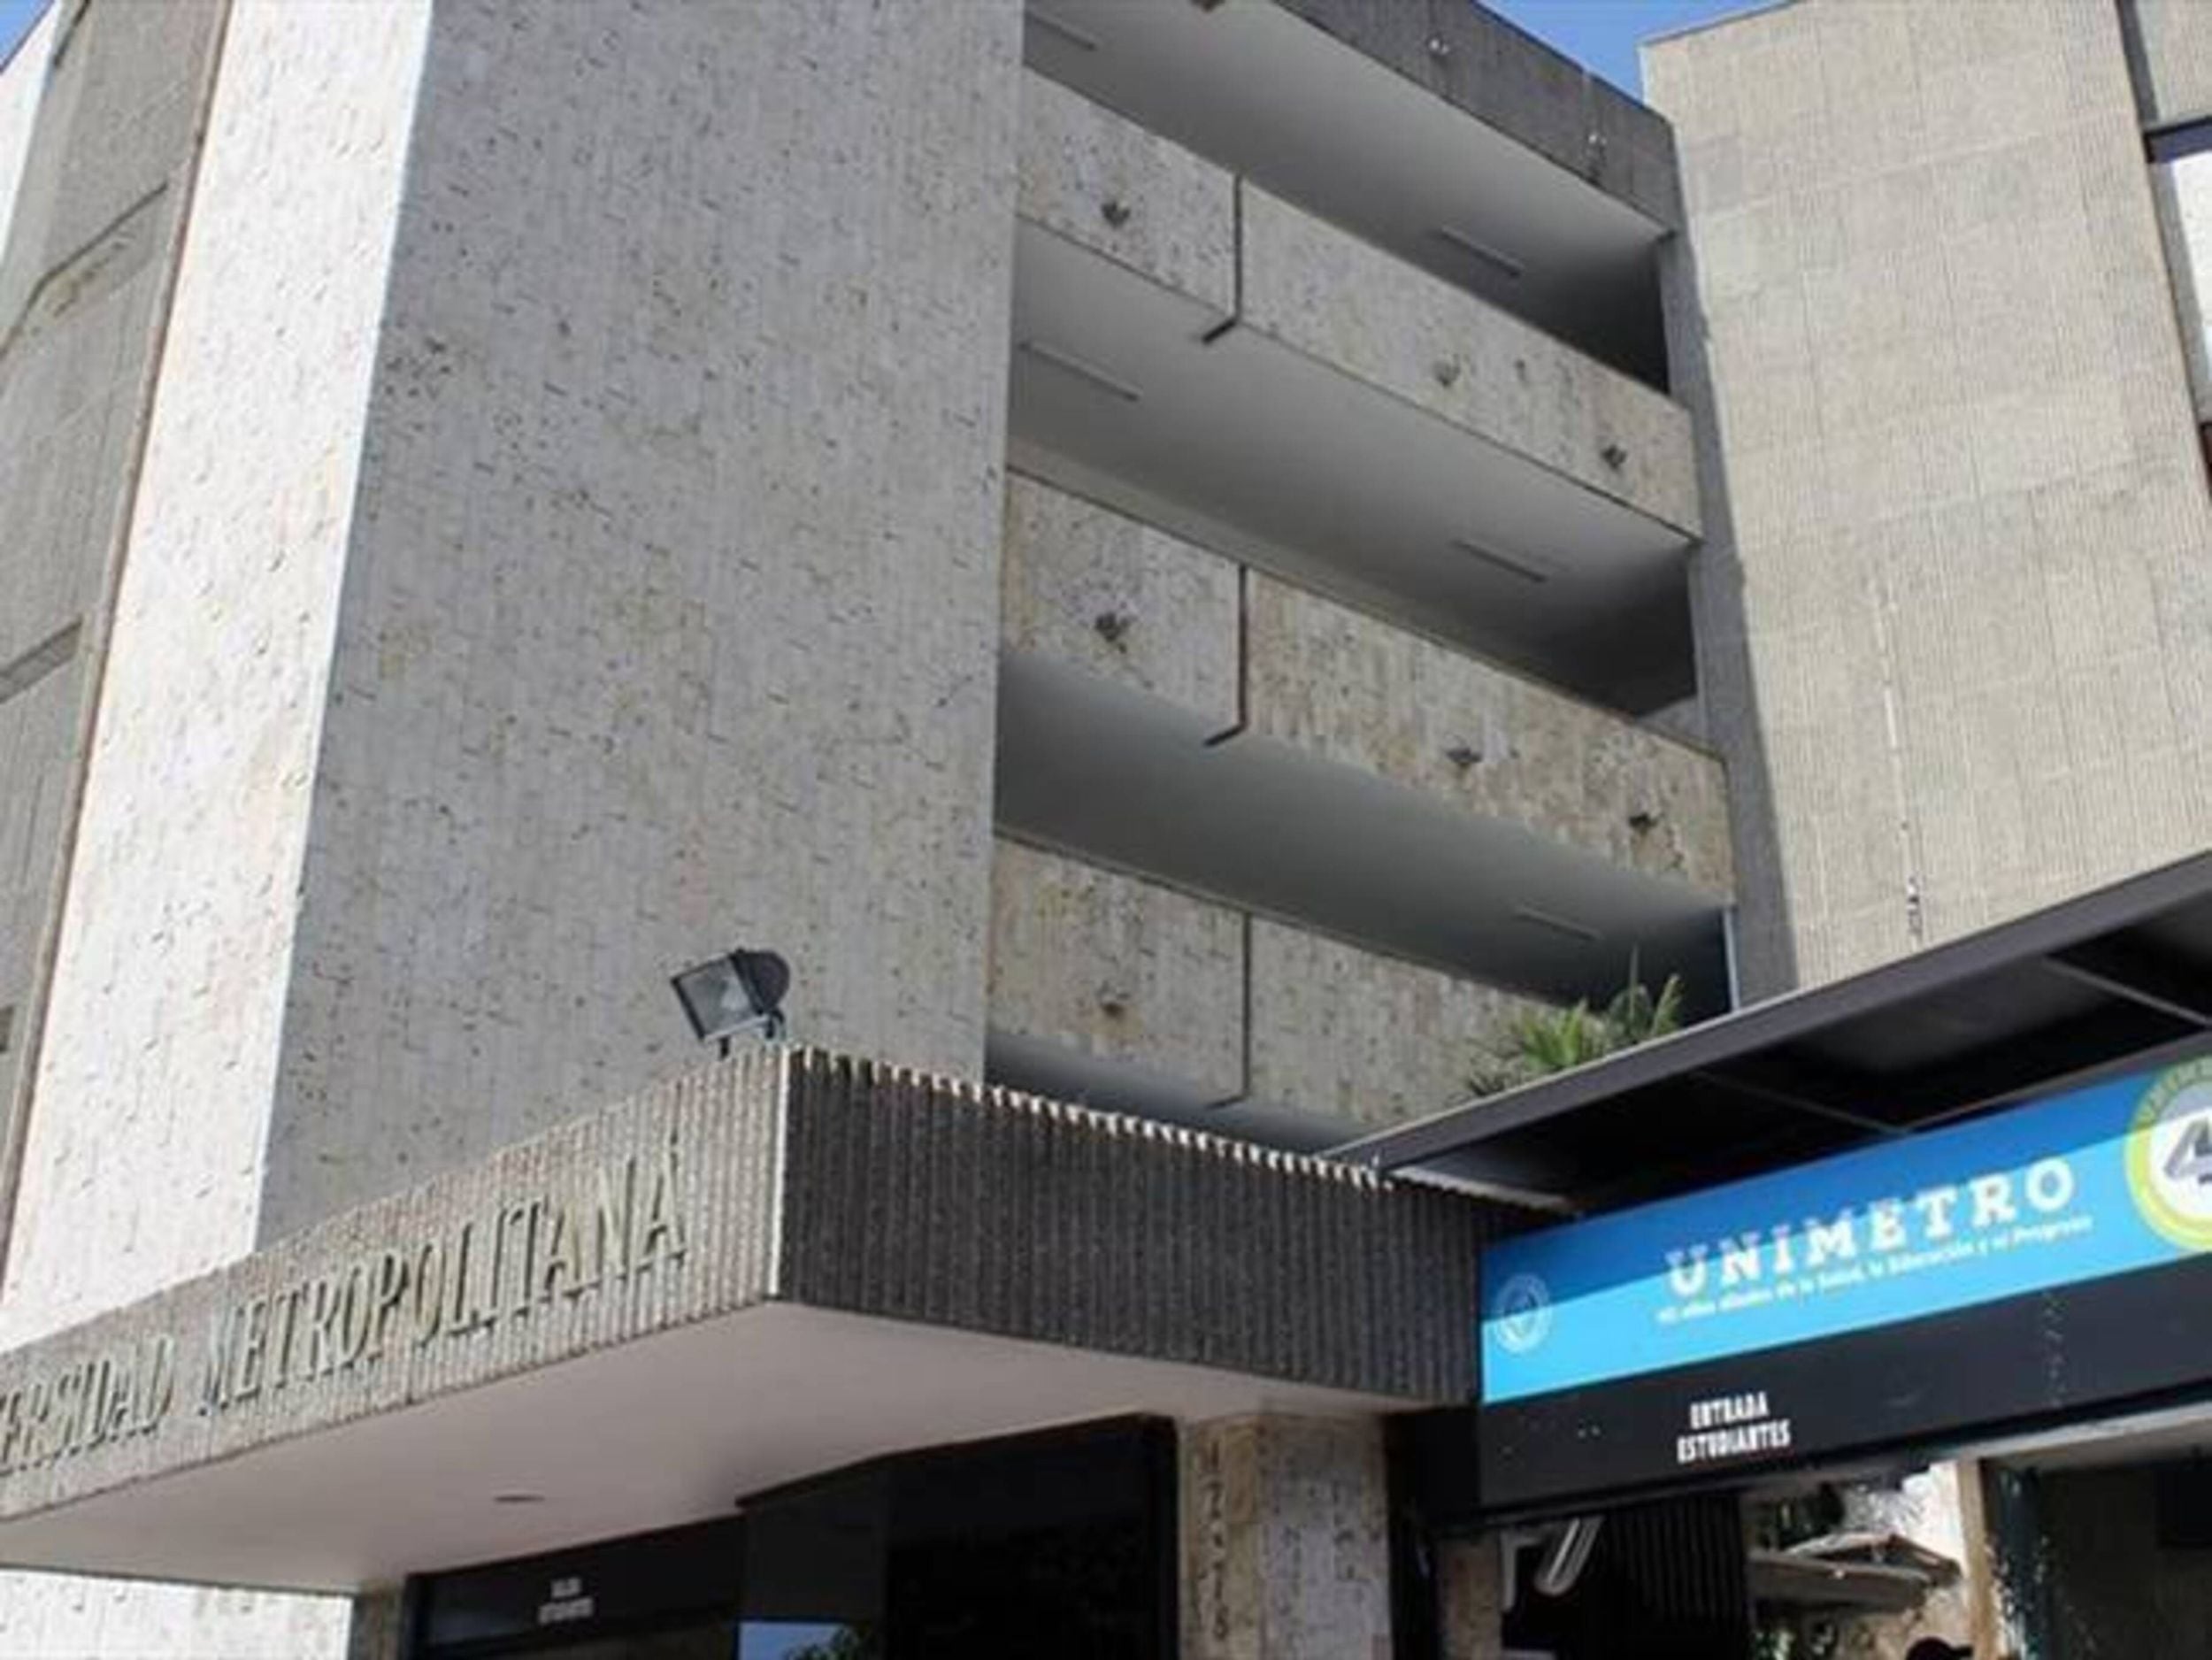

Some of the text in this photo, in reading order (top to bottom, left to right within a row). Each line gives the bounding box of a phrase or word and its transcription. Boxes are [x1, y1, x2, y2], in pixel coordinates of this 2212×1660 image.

[1664, 1157, 2074, 1296] UNIMETRO
[197, 1139, 688, 1418] METROPOLITANA
[1677, 1418, 1791, 1464] ESTUDIANTES
[1690, 1391, 1769, 1430] ENTRADA
